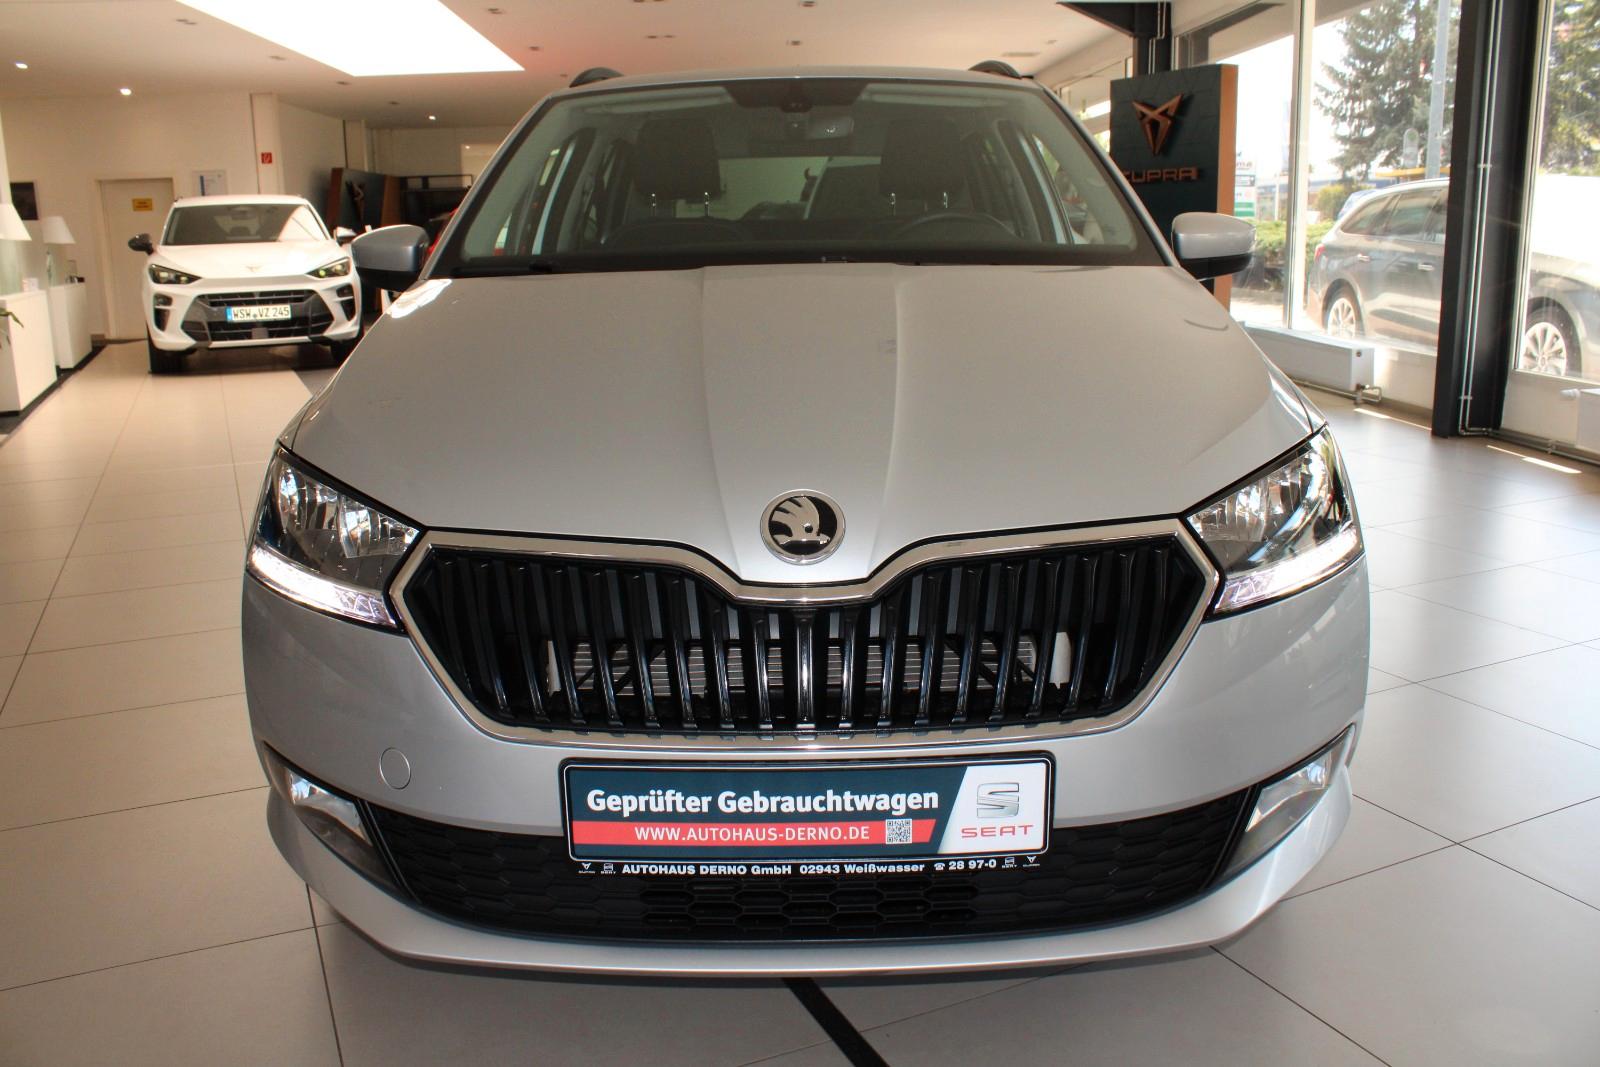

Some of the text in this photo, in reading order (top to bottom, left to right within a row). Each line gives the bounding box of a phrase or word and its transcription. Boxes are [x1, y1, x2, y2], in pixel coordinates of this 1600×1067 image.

[587, 789, 939, 818] Geprüfter Gebrauchtwagen
[634, 826, 870, 842] WWW.AUTOHAUS-DERNO.DE
[961, 824, 1034, 839] SEAT
[621, 864, 696, 875] AUTOHAUS
[699, 864, 747, 875] DERNO
[750, 864, 792, 875] GmbH
[799, 864, 841, 874] 02943
[843, 863, 925, 875] Weißwasser
[948, 860, 966, 870] 28
[968, 858, 997, 869] 97-0
